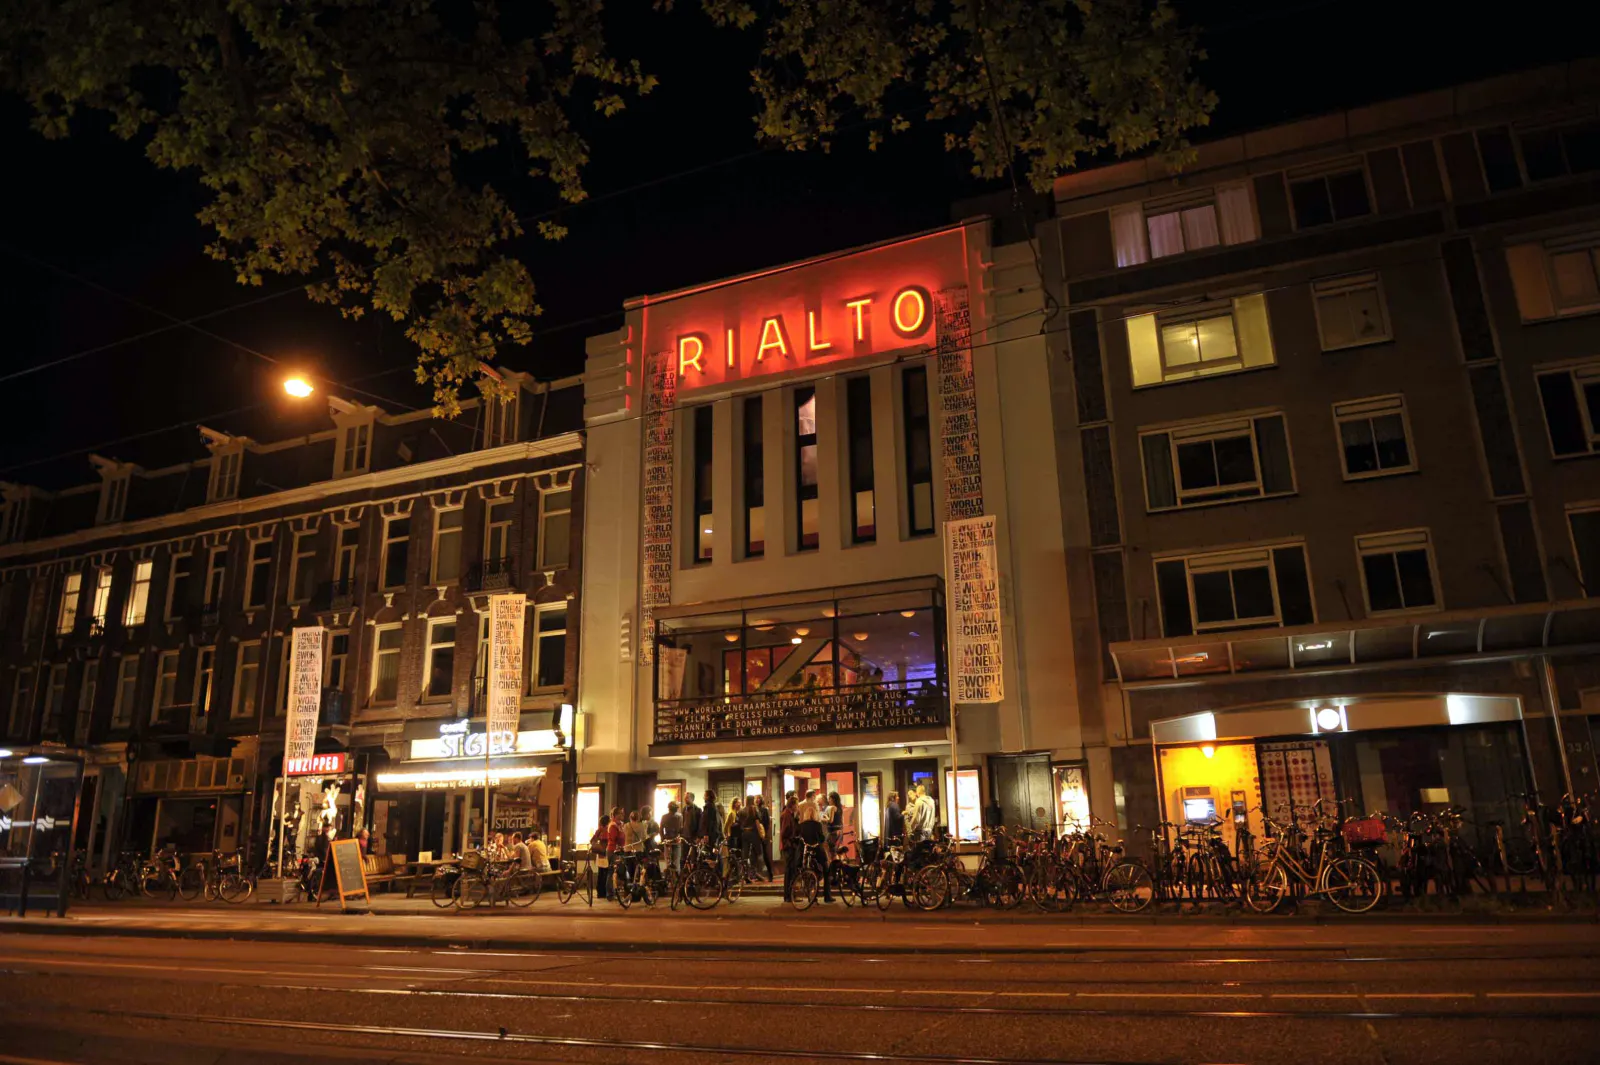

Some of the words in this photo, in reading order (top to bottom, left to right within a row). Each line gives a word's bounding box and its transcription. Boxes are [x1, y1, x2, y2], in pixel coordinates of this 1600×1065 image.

[679, 289, 925, 377] RIALTO
[944, 399, 977, 411] CINEMA
[948, 475, 981, 487] WORLD
[949, 483, 981, 495] CINEMA
[951, 497, 983, 509] WORLD
[951, 506, 983, 518] CINEMA
[959, 529, 993, 543] CINEMA
[963, 580, 996, 594] WORLD
[962, 592, 997, 605] CINEMA
[963, 623, 999, 636] CINEMA
[963, 643, 1000, 656] WORLD
[964, 655, 1002, 668] CINEMA
[674, 698, 822, 717] WWW.WORLDCINEMAAMSTERDAM.NL
[830, 696, 840, 704] 10
[845, 695, 863, 703] T/M
[867, 693, 878, 701] 21
[884, 691, 907, 700] AUG.
[674, 724, 705, 732] GIANNI
[720, 721, 731, 729] LE
[736, 719, 763, 728] DONNE
[821, 714, 833, 722] LE
[837, 711, 867, 720] GAMIN
[872, 709, 885, 718] AU
[889, 707, 914, 717] VELO
[685, 715, 715, 724] FILMS,
[729, 709, 789, 720] REGISSEURS,
[802, 706, 825, 715] OPEN
[830, 704, 852, 713] AIR,
[664, 730, 716, 741] SEPARATION
[735, 729, 745, 737] IL
[751, 726, 784, 735] GRANDE
[789, 723, 818, 733] SOGNO
[835, 716, 939, 729] WWW.RIALTOFILM.NL
[288, 756, 338, 772] UNZIPPED
